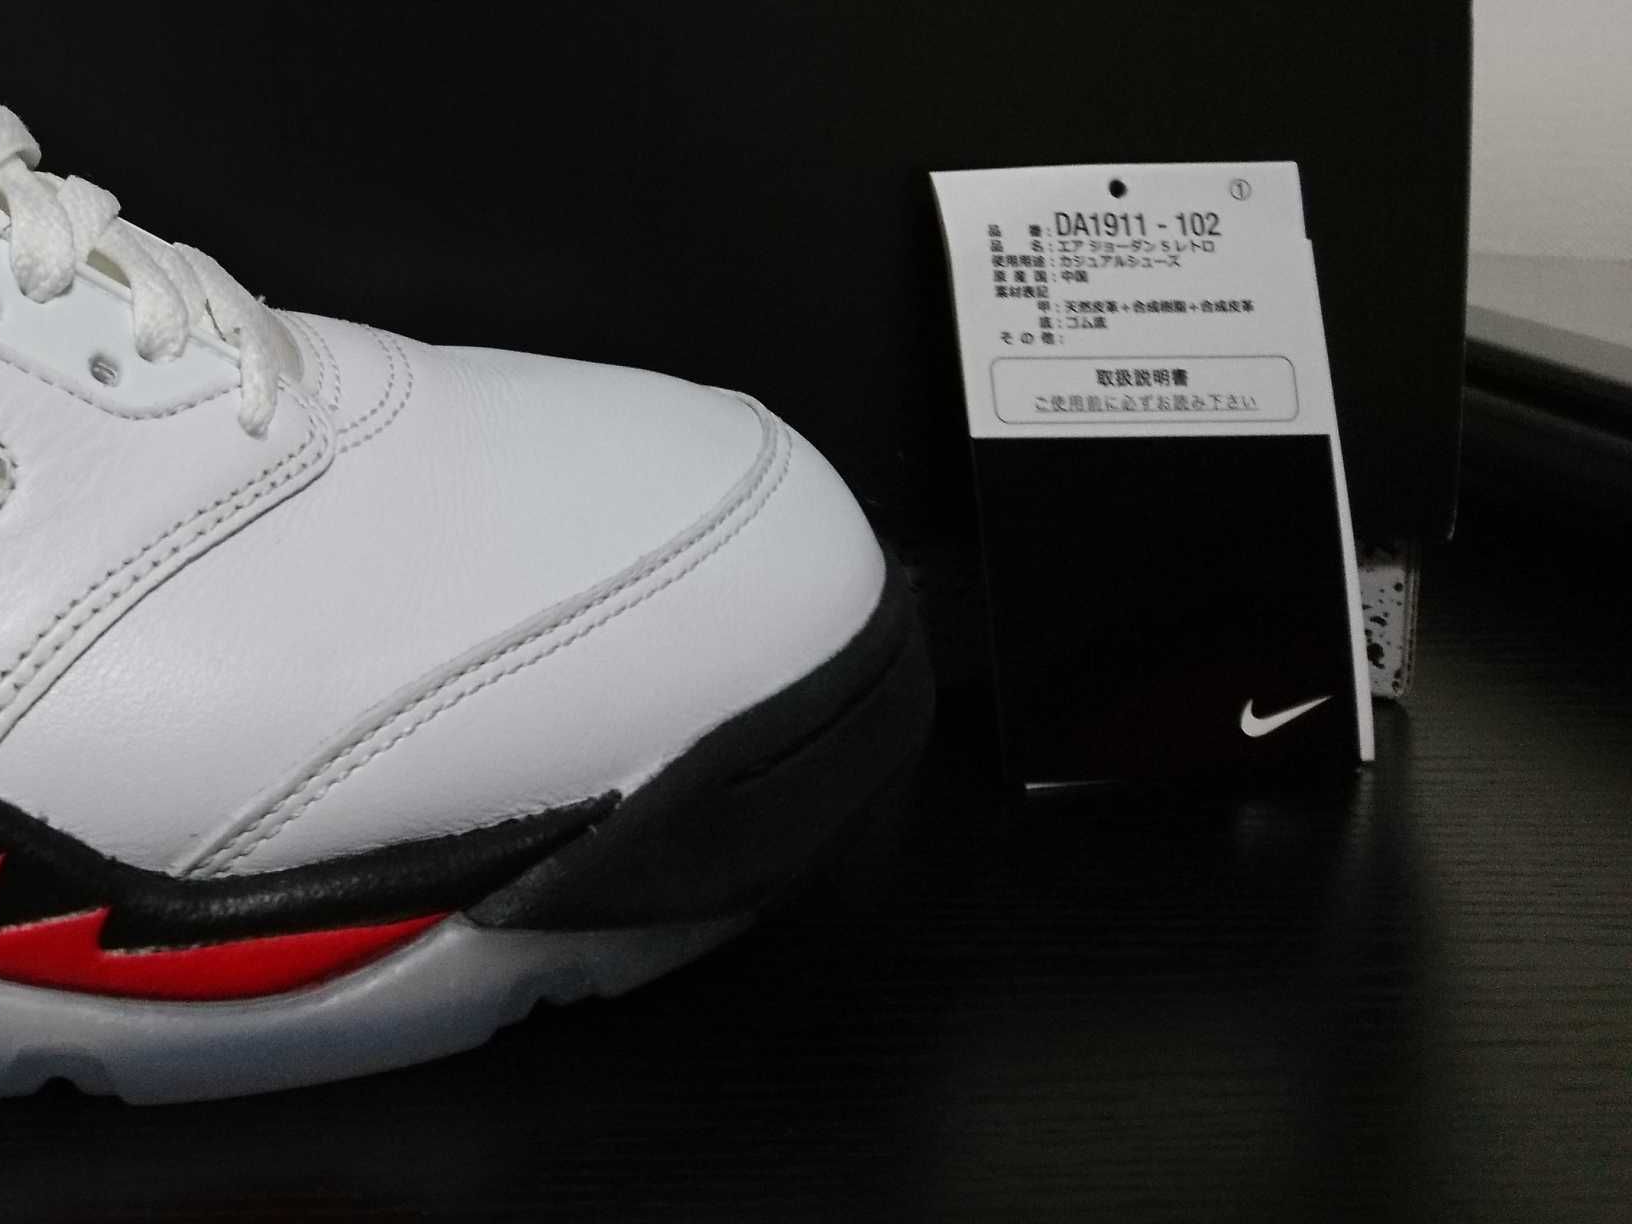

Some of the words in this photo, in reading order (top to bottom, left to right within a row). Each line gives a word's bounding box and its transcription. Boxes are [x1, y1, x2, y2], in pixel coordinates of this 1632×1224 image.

[1095, 368, 1188, 387] 取扱説明書
